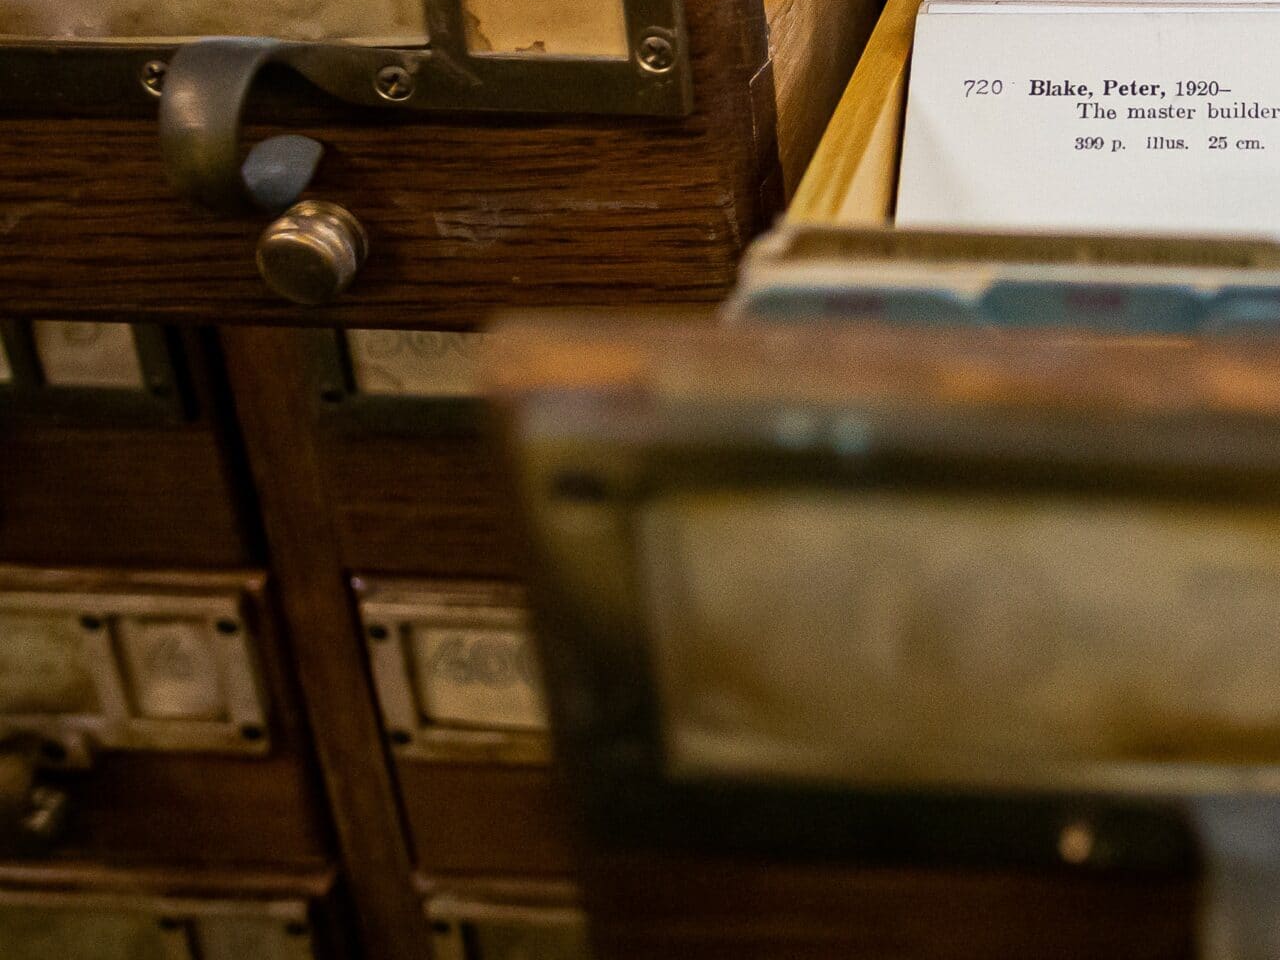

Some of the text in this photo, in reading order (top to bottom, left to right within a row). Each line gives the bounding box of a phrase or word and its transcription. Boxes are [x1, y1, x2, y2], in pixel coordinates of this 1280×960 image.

[963, 79, 1003, 97] 720
[1028, 80, 1094, 98] Blake,
[1102, 80, 1166, 98] Peter,
[1076, 102, 1117, 120] The
[1127, 103, 1196, 120] master
[1074, 136, 1266, 152] 399 p. illus. 25 cm.
